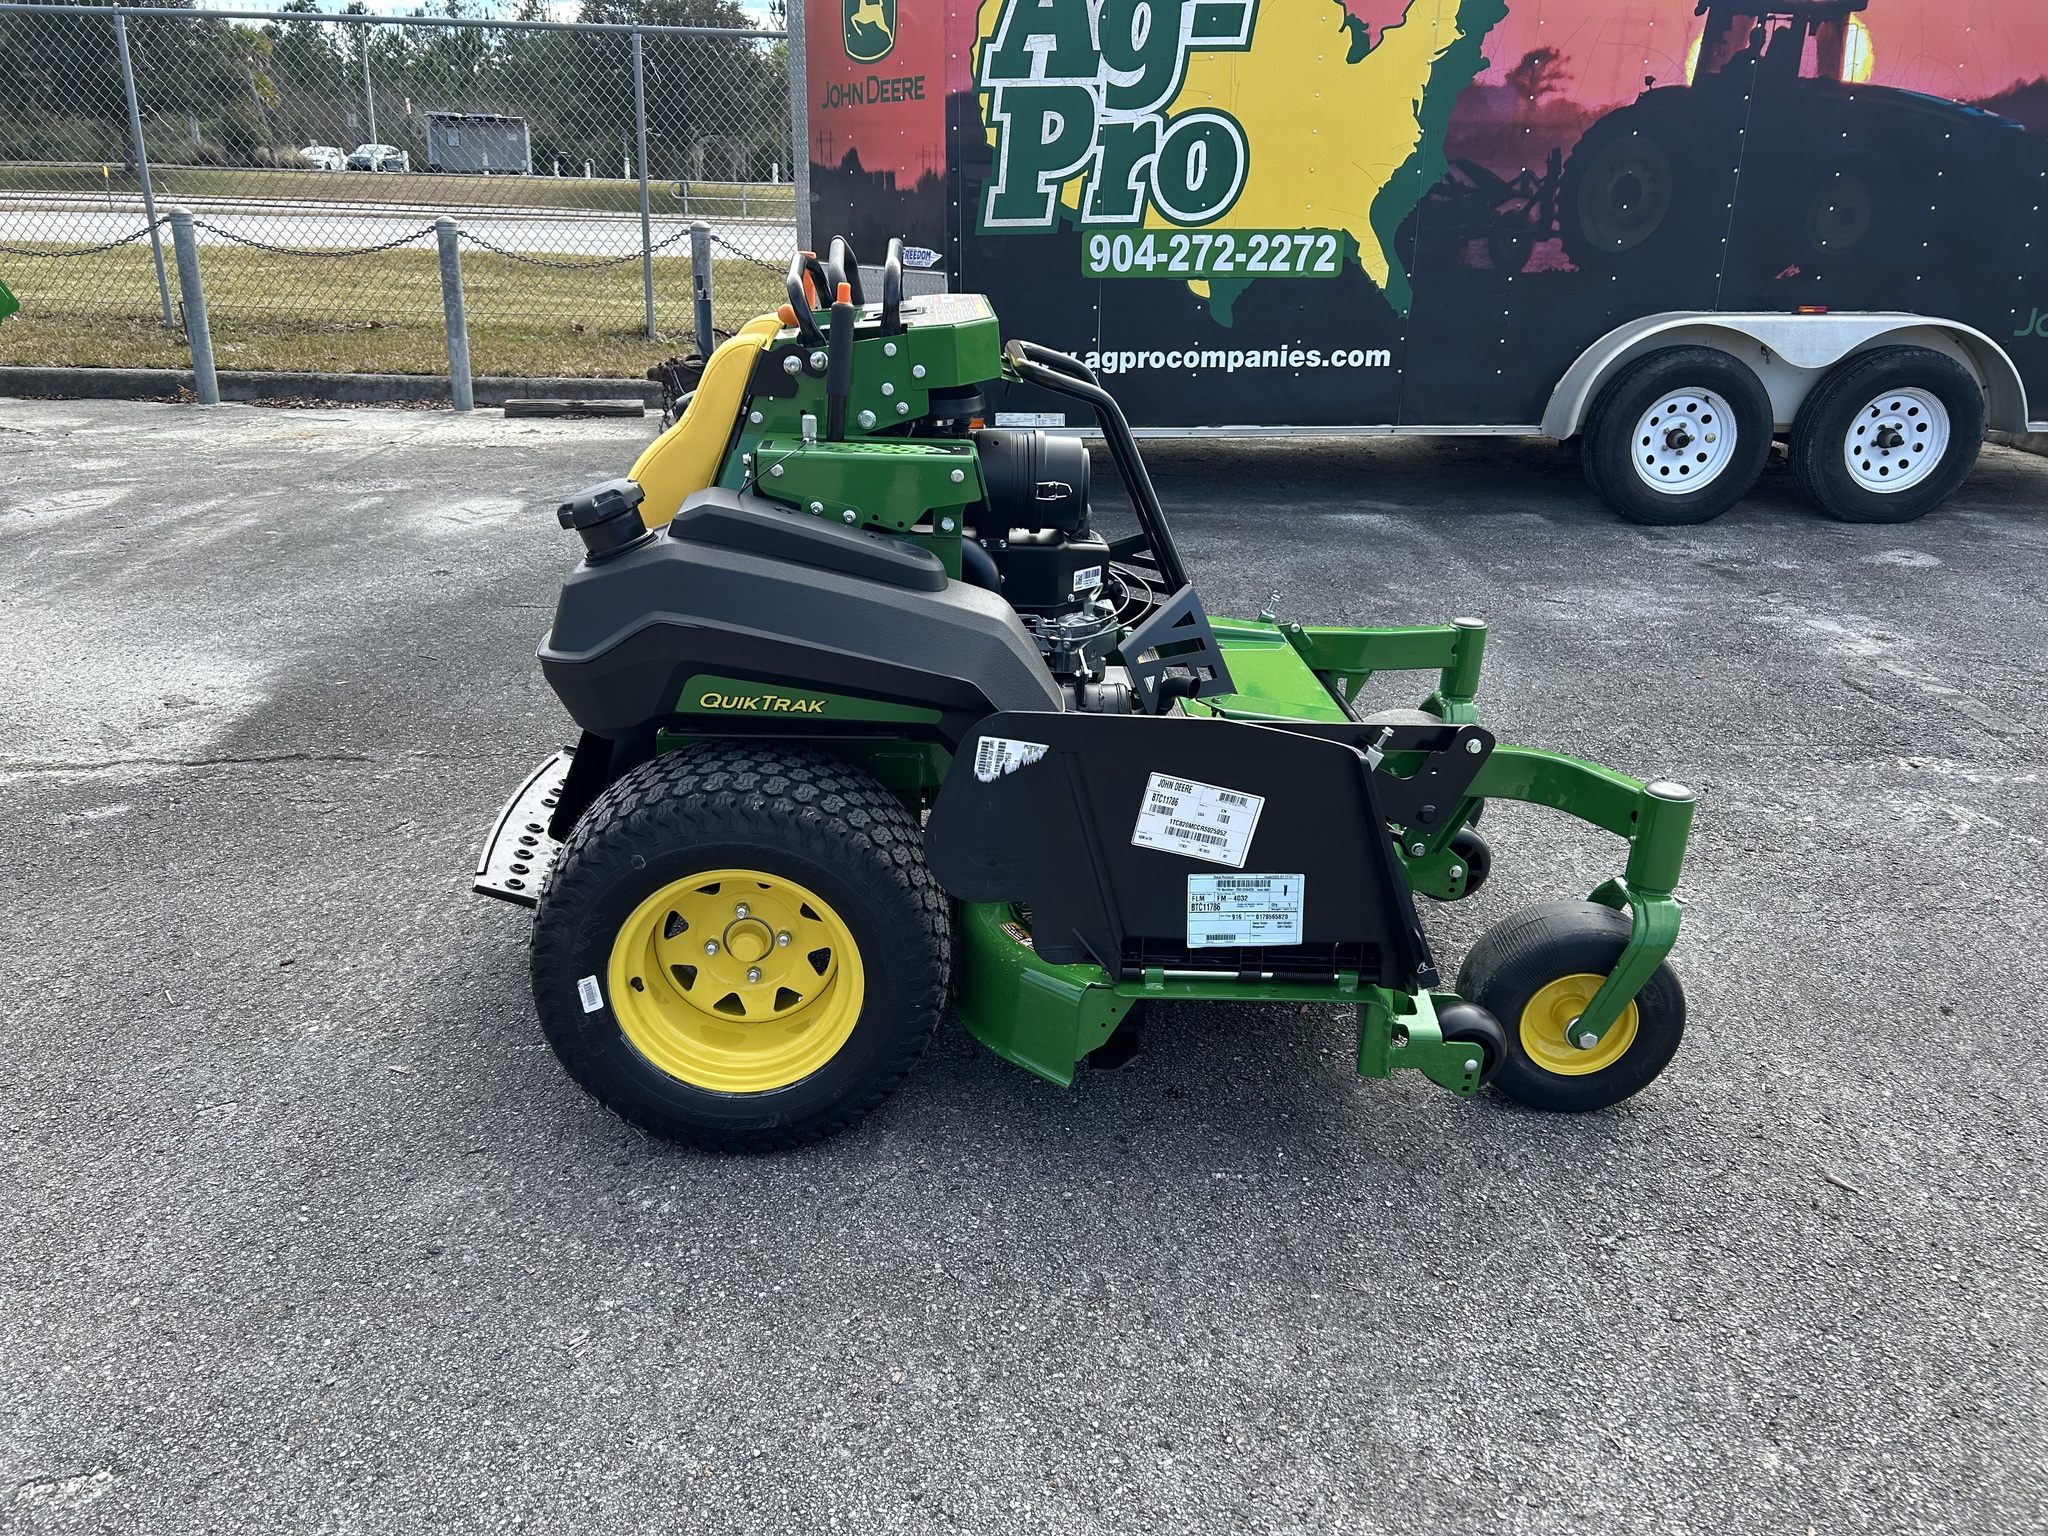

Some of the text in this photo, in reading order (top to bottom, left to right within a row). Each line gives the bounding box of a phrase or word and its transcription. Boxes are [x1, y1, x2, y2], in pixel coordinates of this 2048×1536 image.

[981, 0, 1254, 116] Ag-
[822, 75, 925, 109] JOHN DEERE
[984, 85, 1244, 227] Pro
[903, 248, 932, 261] REEDOM
[1089, 234, 1337, 272] 904-272-2272
[1041, 344, 1391, 374] agprocompanies.com
[699, 692, 827, 713] QUIKTRAK
[1157, 779, 1193, 794] JOHN DEERE
[1151, 793, 1179, 806] BTC11786
[1191, 902, 1221, 912] BTC11786
